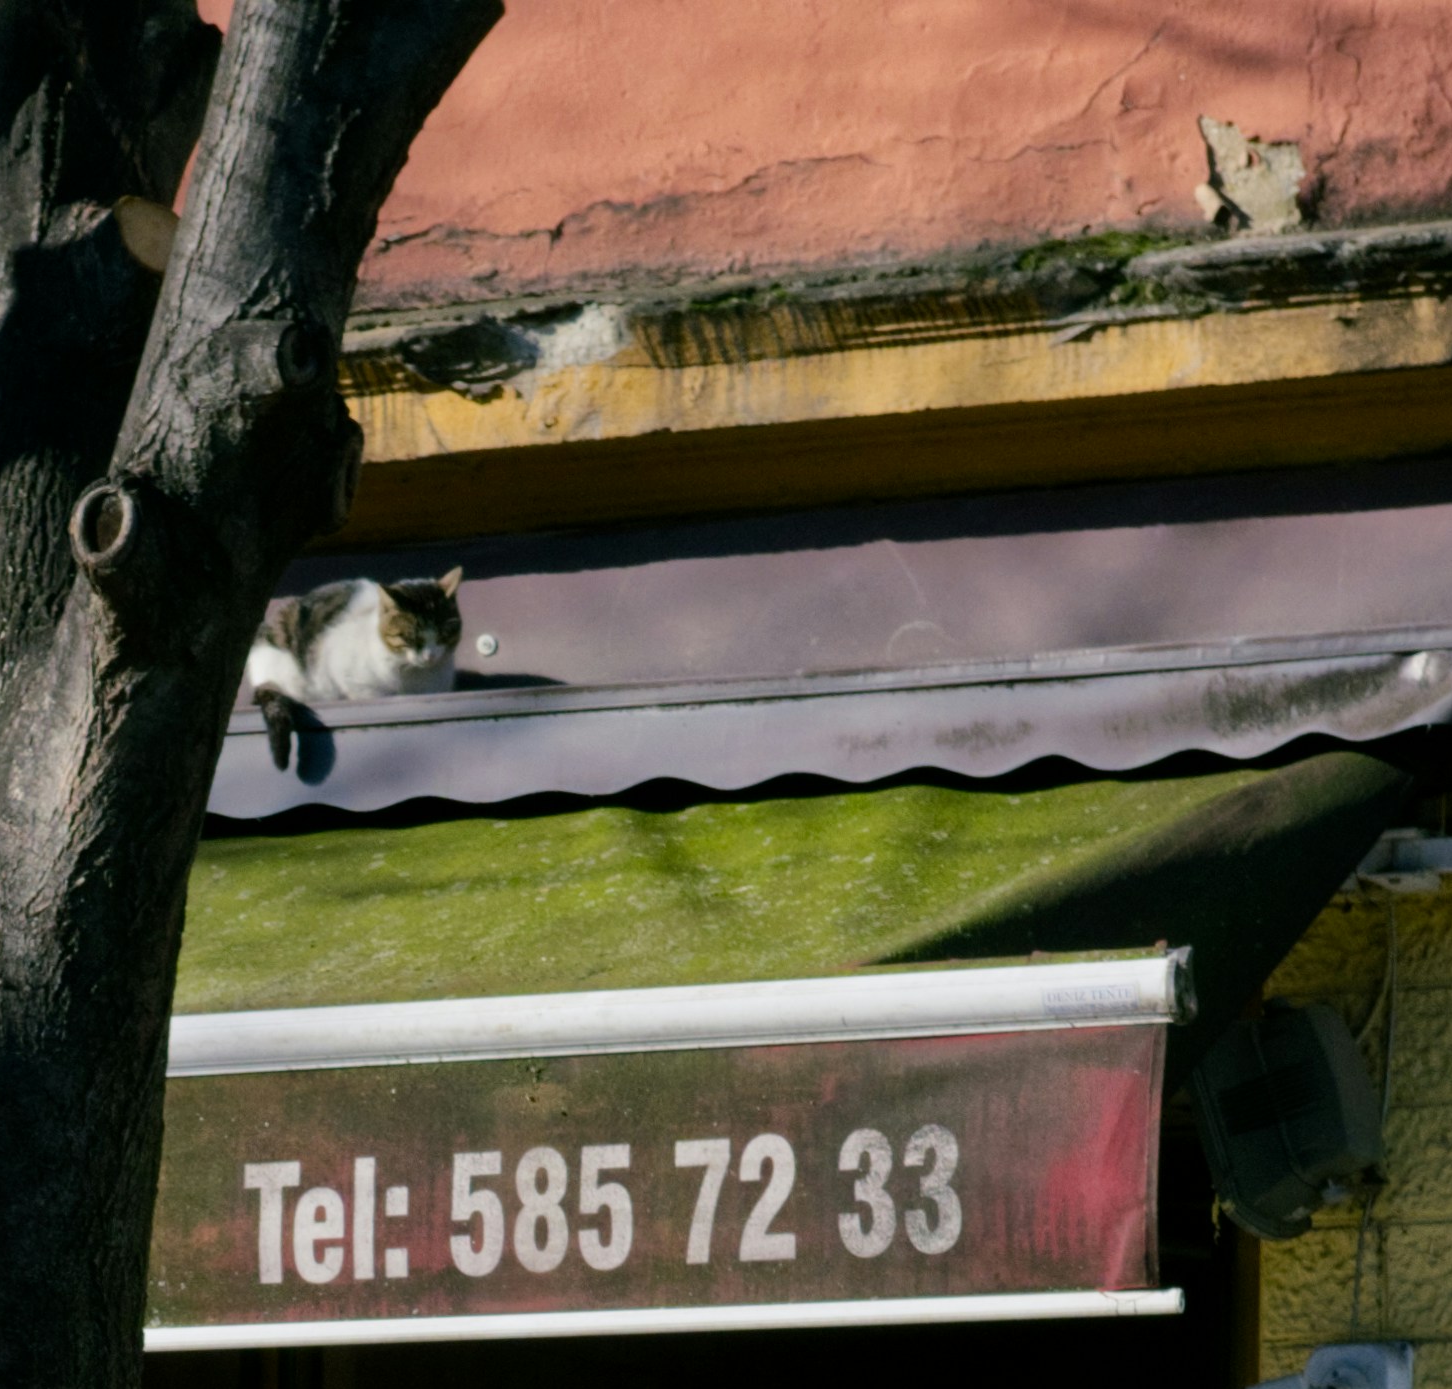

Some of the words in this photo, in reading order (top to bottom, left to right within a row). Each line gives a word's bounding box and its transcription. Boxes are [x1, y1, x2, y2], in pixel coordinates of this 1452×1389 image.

[243, 1155, 410, 1285] Tel:
[449, 1143, 634, 1278] 585
[673, 1132, 797, 1265] 72
[837, 1123, 963, 1258] 33
